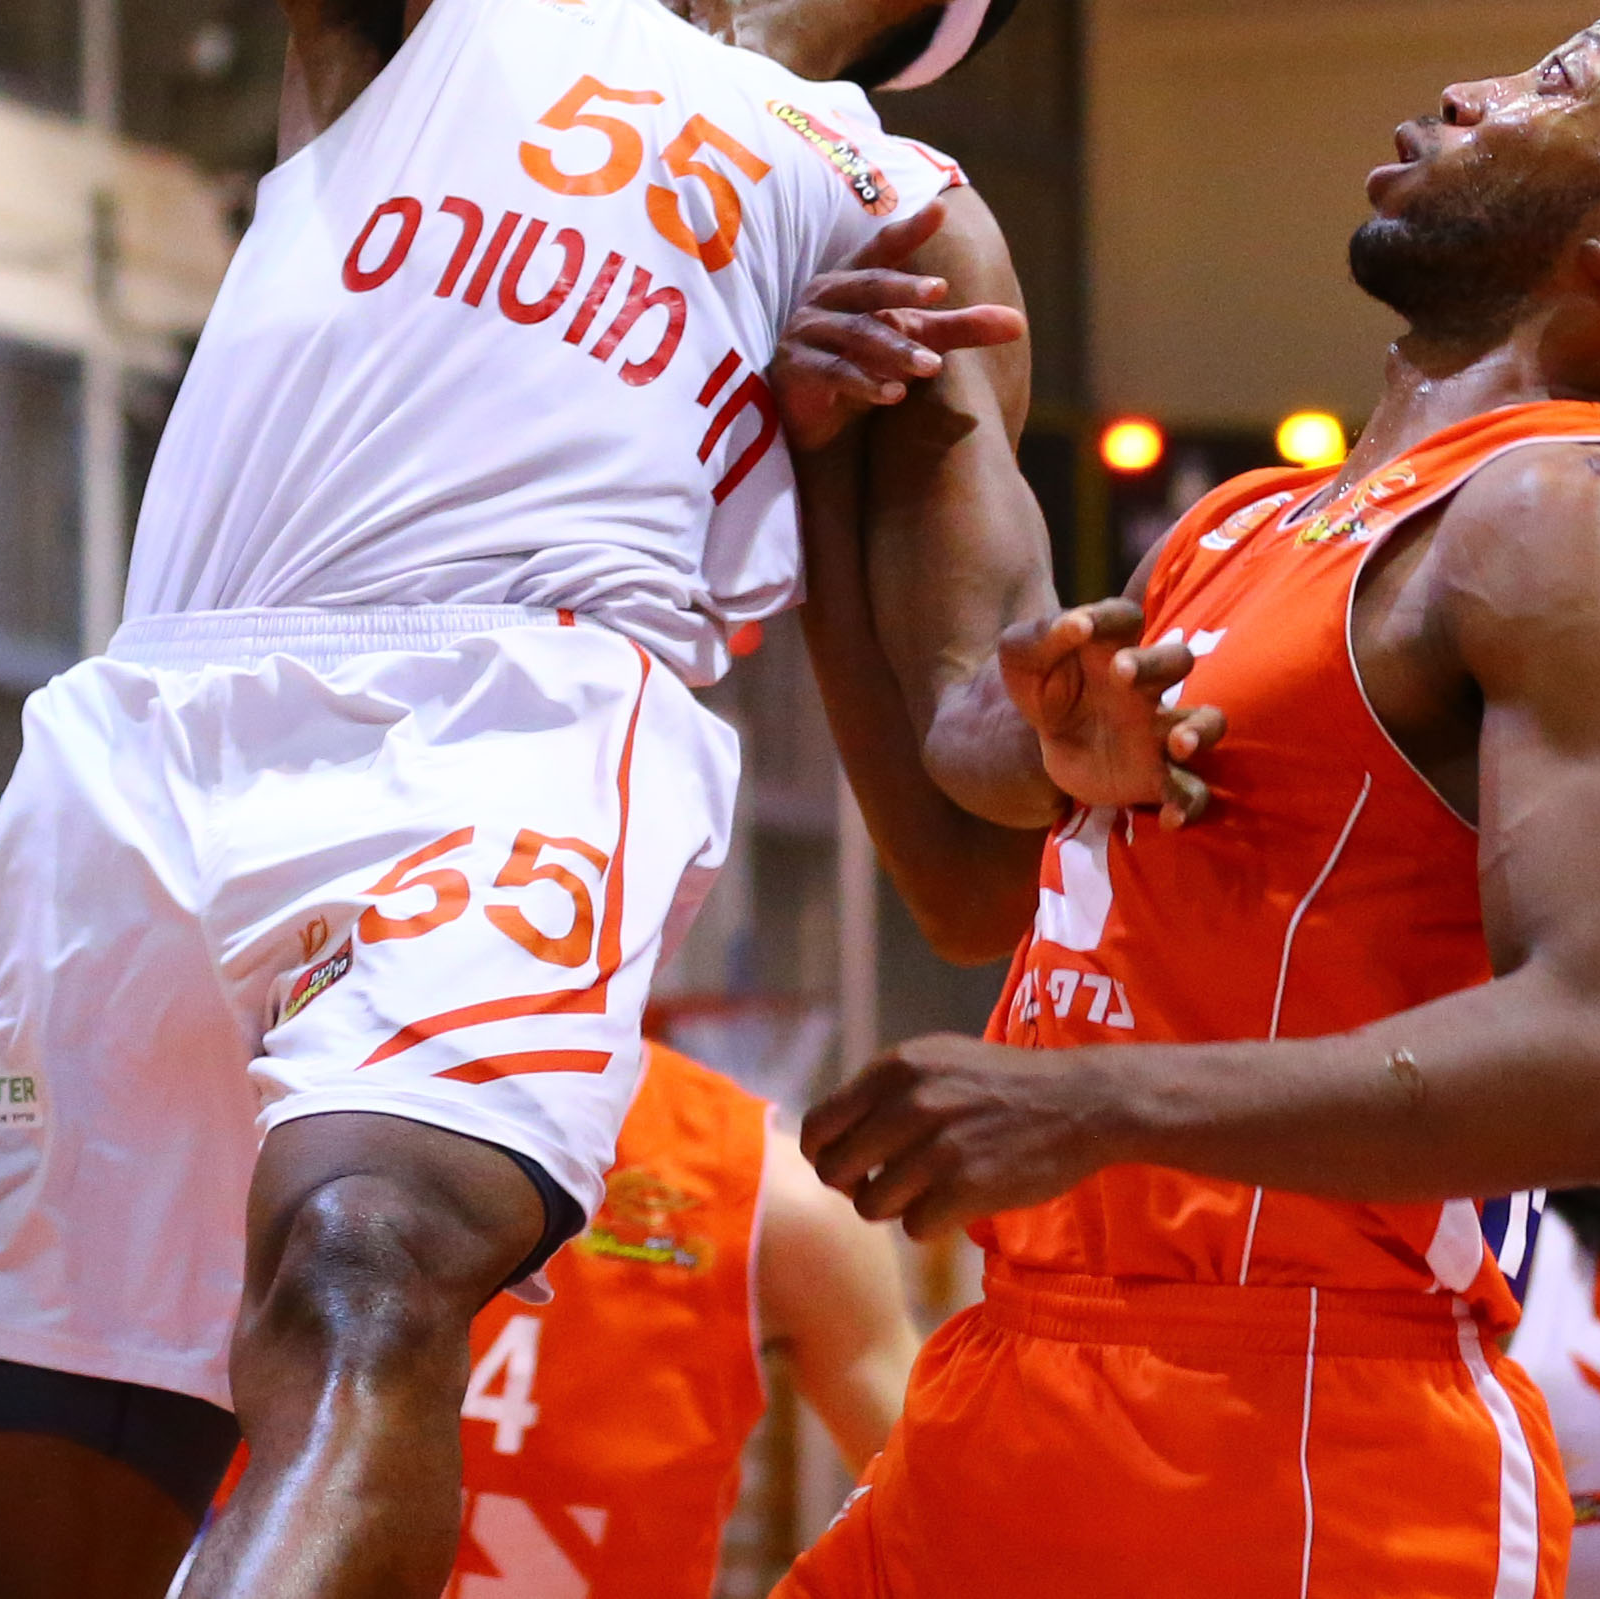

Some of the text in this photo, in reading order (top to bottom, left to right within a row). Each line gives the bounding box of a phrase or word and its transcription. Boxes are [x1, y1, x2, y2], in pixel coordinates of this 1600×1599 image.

[518, 74, 771, 272] 55
[342, 196, 780, 506] חי מוטורס
[358, 826, 608, 968] 55
[461, 1315, 541, 1455] 4
